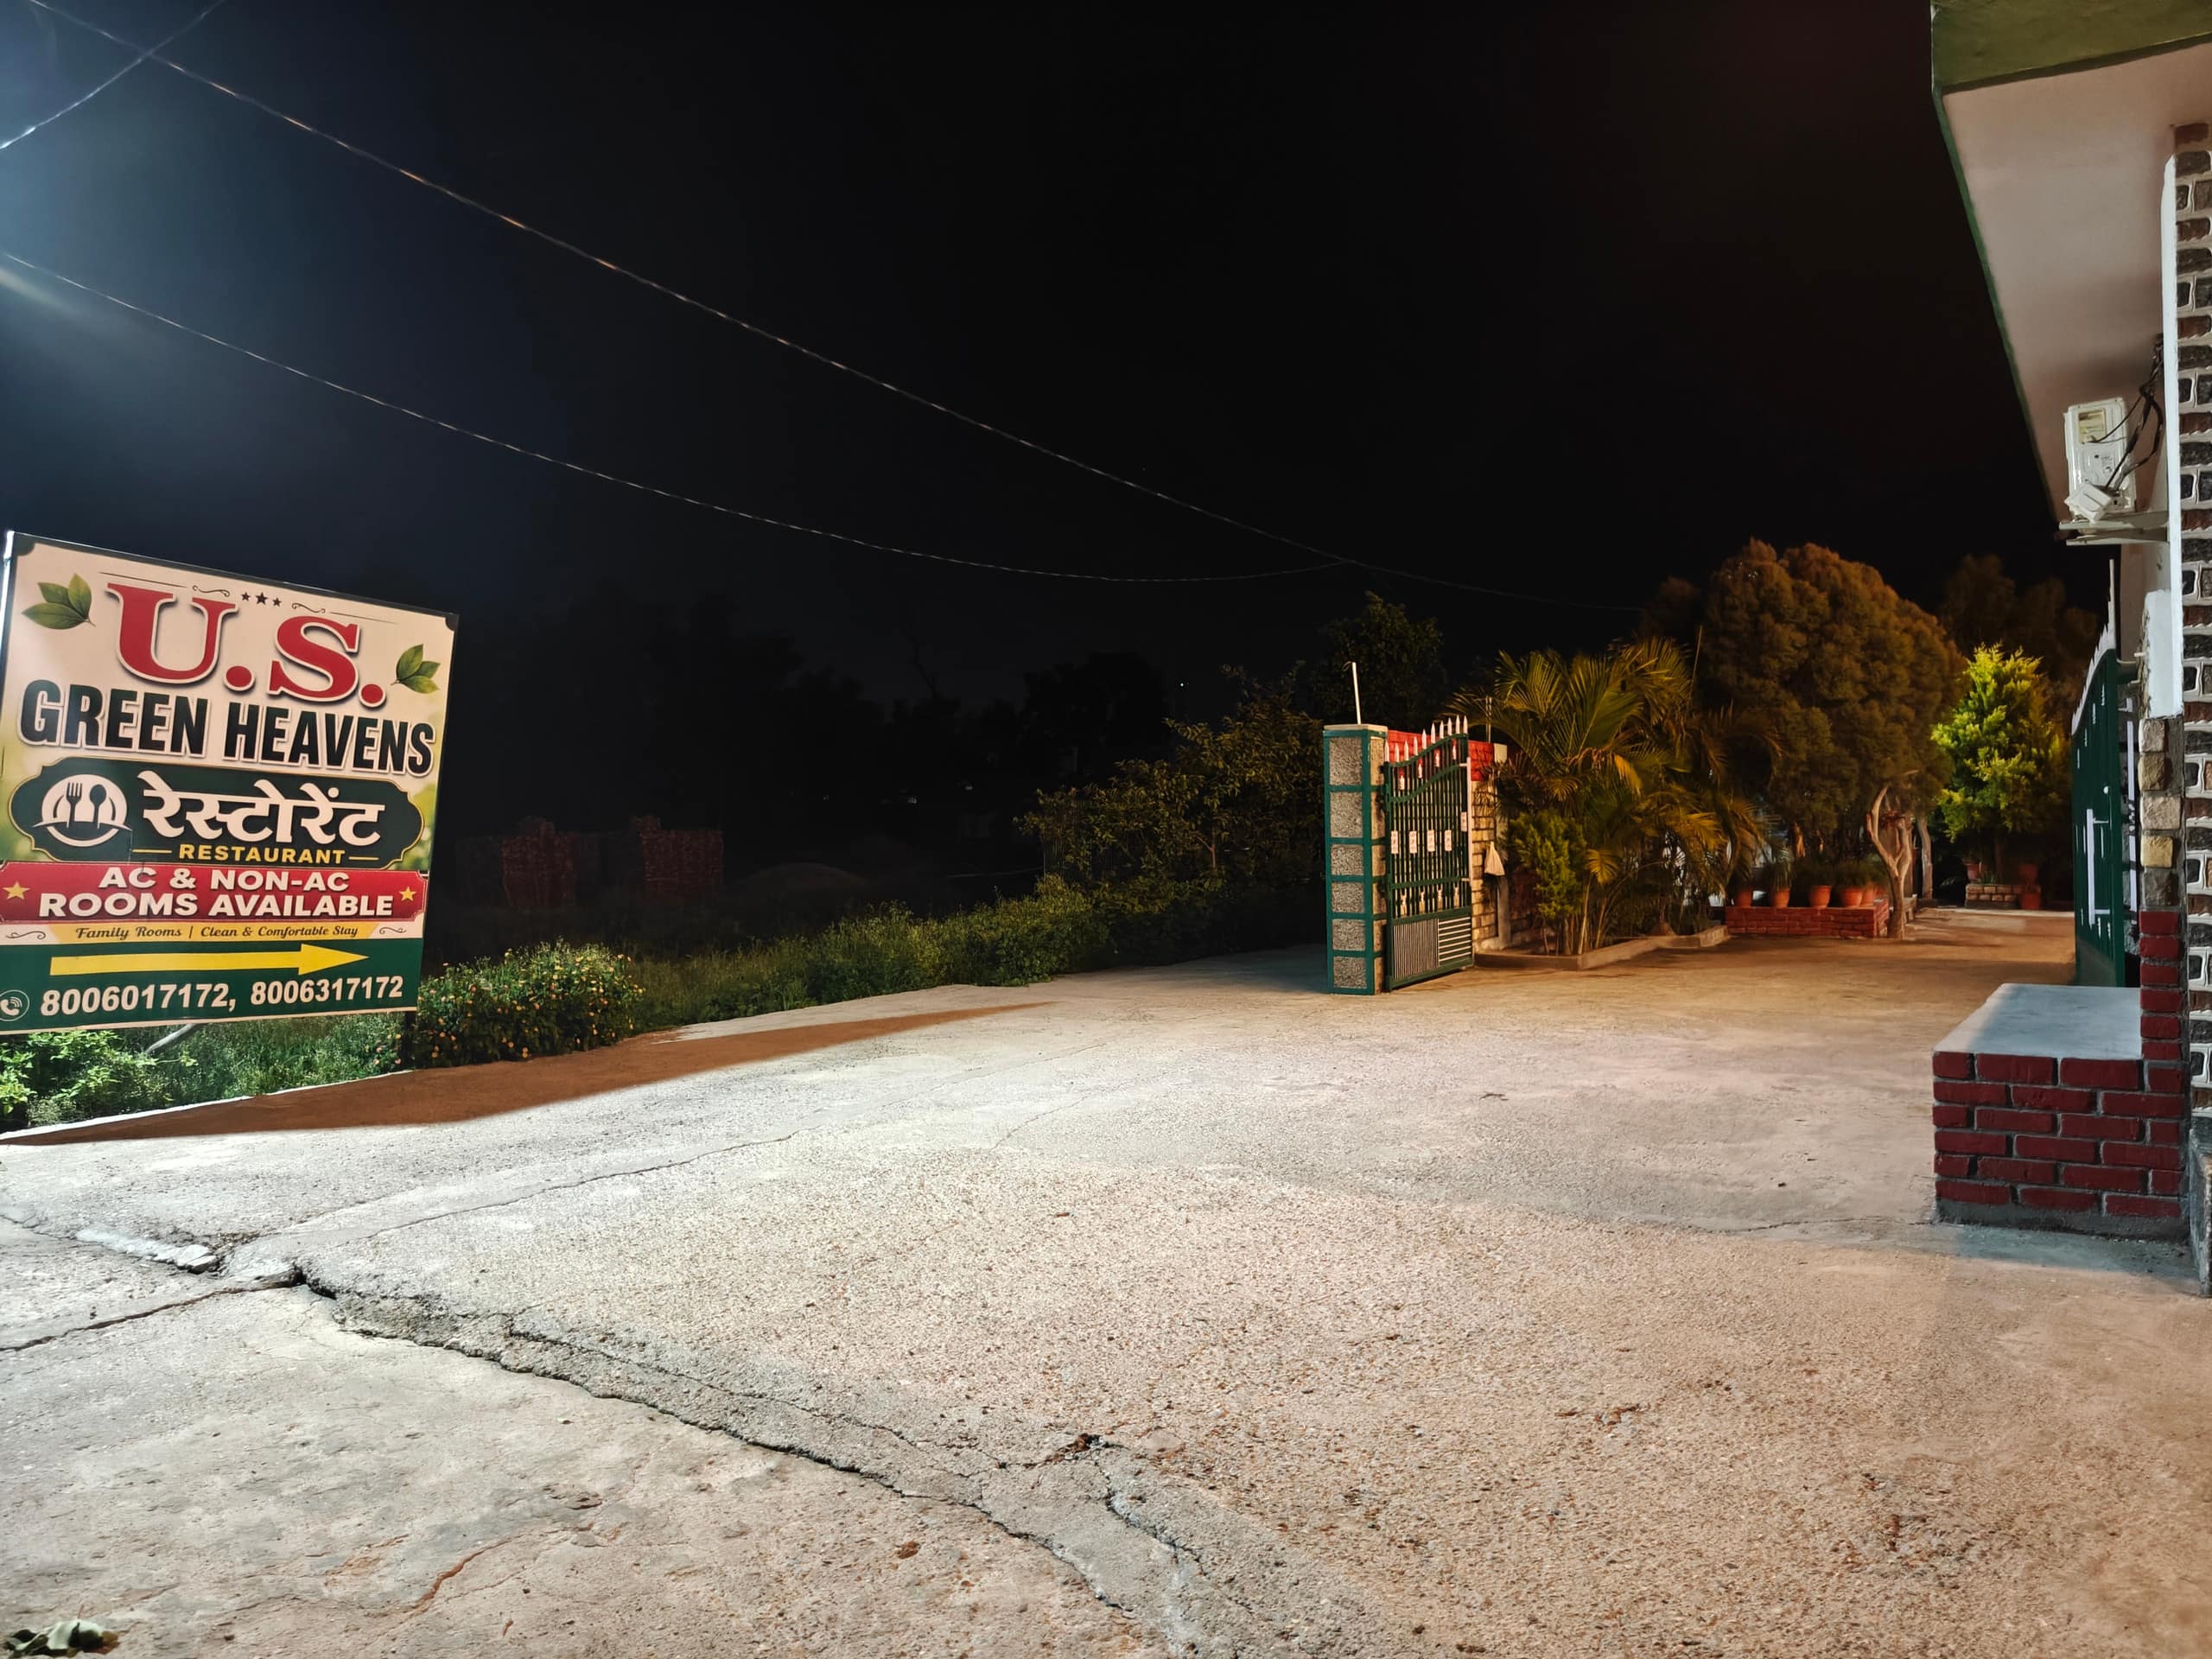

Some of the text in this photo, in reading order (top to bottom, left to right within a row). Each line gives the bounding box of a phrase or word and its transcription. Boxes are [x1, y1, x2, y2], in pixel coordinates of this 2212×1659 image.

[106, 583, 386, 709] U.S.
[20, 679, 435, 776] GREEN HEAVENS
[137, 770, 385, 846] रेस्टोरेंट
[179, 843, 346, 863] RESTAURANT
[99, 867, 350, 892] AC & NON-AC
[39, 893, 393, 918] ROOMS AVAILABLE
[75, 925, 359, 940] Family Rooms Clean & Comfortable Stay
[41, 976, 404, 1015] 8006017172, 8006317172
